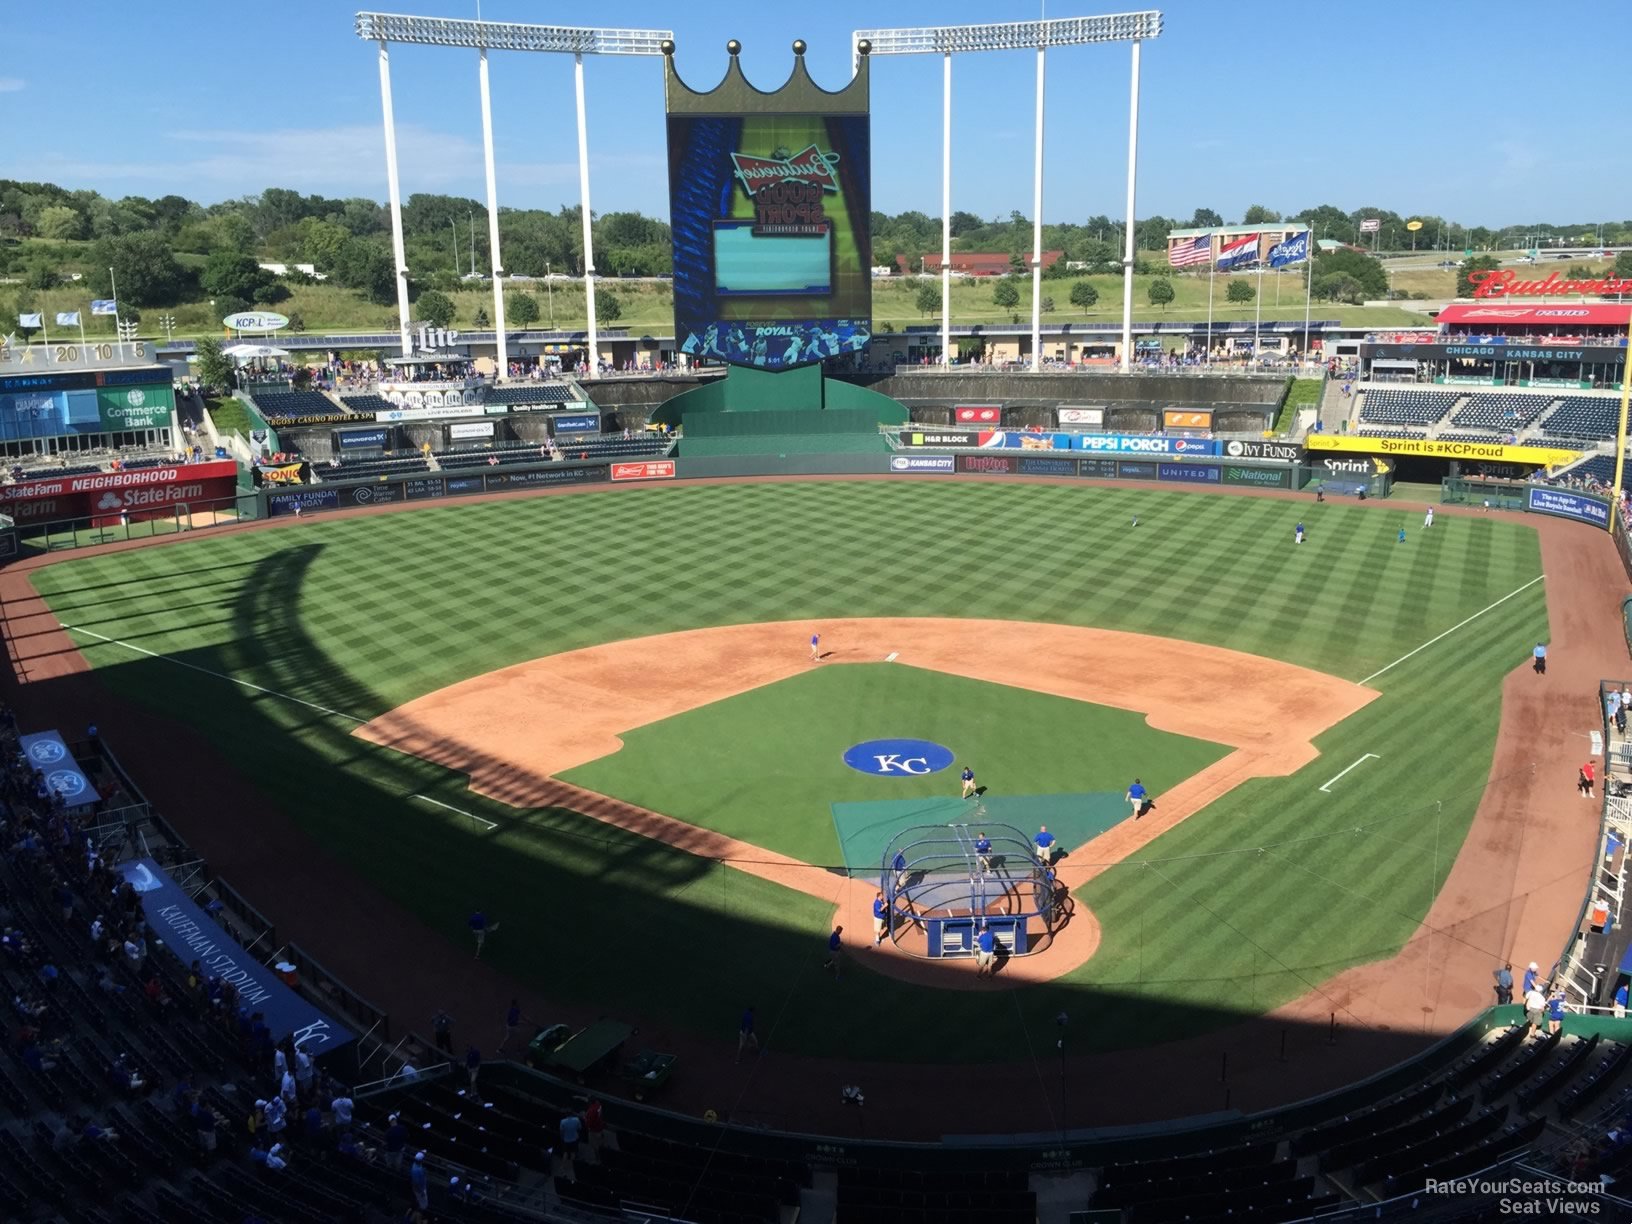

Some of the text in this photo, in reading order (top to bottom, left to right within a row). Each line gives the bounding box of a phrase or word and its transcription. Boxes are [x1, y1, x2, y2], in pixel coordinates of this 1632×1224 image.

[755, 326, 794, 336] ROYAL
[418, 328, 459, 353] Lite
[56, 346, 78, 363] 20
[94, 343, 113, 361] 10
[134, 342, 146, 358] 5
[1446, 347, 1495, 355] CHICAGO
[1506, 350, 1583, 359] KANSAS CITY
[106, 405, 167, 418] Commerce
[297, 415, 327, 424] CASINO
[328, 413, 352, 422] HOTEL
[361, 412, 375, 420] SPA
[124, 416, 154, 428] Bank
[342, 436, 377, 444] GRUNDFOS
[925, 435, 968, 443] H&R BLOCK
[1082, 436, 1169, 452] PEPSI PORCH
[1309, 439, 1330, 448] Sprint
[1186, 443, 1205, 451] pepsi
[1243, 443, 1297, 459] IVY FUNDS
[1380, 439, 1504, 458] Sprint is #KCProud
[910, 459, 937, 467] KANSAS
[937, 459, 952, 467] CITY
[1323, 458, 1370, 476] Sprint
[1477, 463, 1515, 476] Sprint
[262, 467, 300, 482] SONIC
[536, 471, 565, 480] Network
[573, 470, 584, 478] KC
[1162, 468, 1206, 478] UNITED
[1239, 469, 1282, 482] National
[71, 469, 178, 492] NEIGHBORHOOD
[270, 489, 338, 504] FAMILY FUNDAY
[373, 489, 396, 498] Warner
[373, 495, 392, 503] Cable
[1541, 493, 1552, 501] The
[1558, 496, 1569, 505] App
[1533, 499, 1583, 515] Live Royals Baseball
[872, 754, 932, 776] KC
[157, 904, 273, 1006] KAUFFMAN STADIUM
